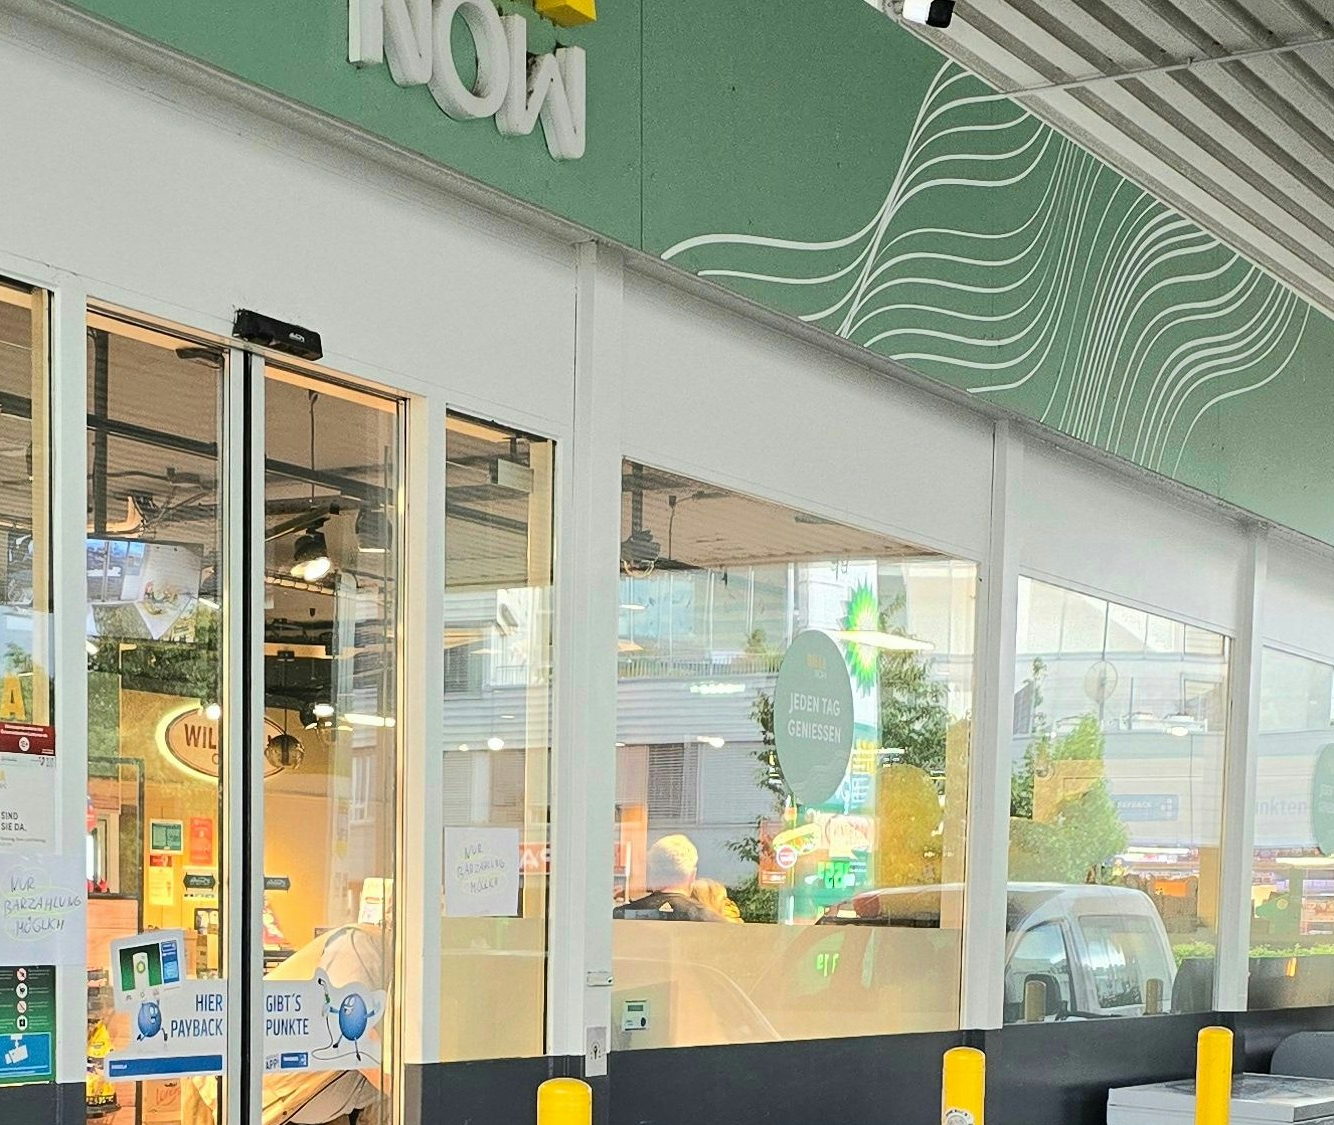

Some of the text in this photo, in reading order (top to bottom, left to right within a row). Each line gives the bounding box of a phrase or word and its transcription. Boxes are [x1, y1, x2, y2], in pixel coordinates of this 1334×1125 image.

[347, 0, 586, 161] NOW
[789, 692, 840, 716] JEDEN TAG
[184, 723, 217, 750] WIL
[788, 720, 841, 743] GENIESSEN
[0, 811, 19, 821] SIND
[2, 821, 13, 831] SIE
[10, 875, 36, 893] NUR
[3, 895, 83, 917] BARZAHLUNG
[195, 993, 223, 1012] HIER
[170, 1018, 223, 1038] PAYBACK
[266, 1018, 309, 1036] PUNKTE
